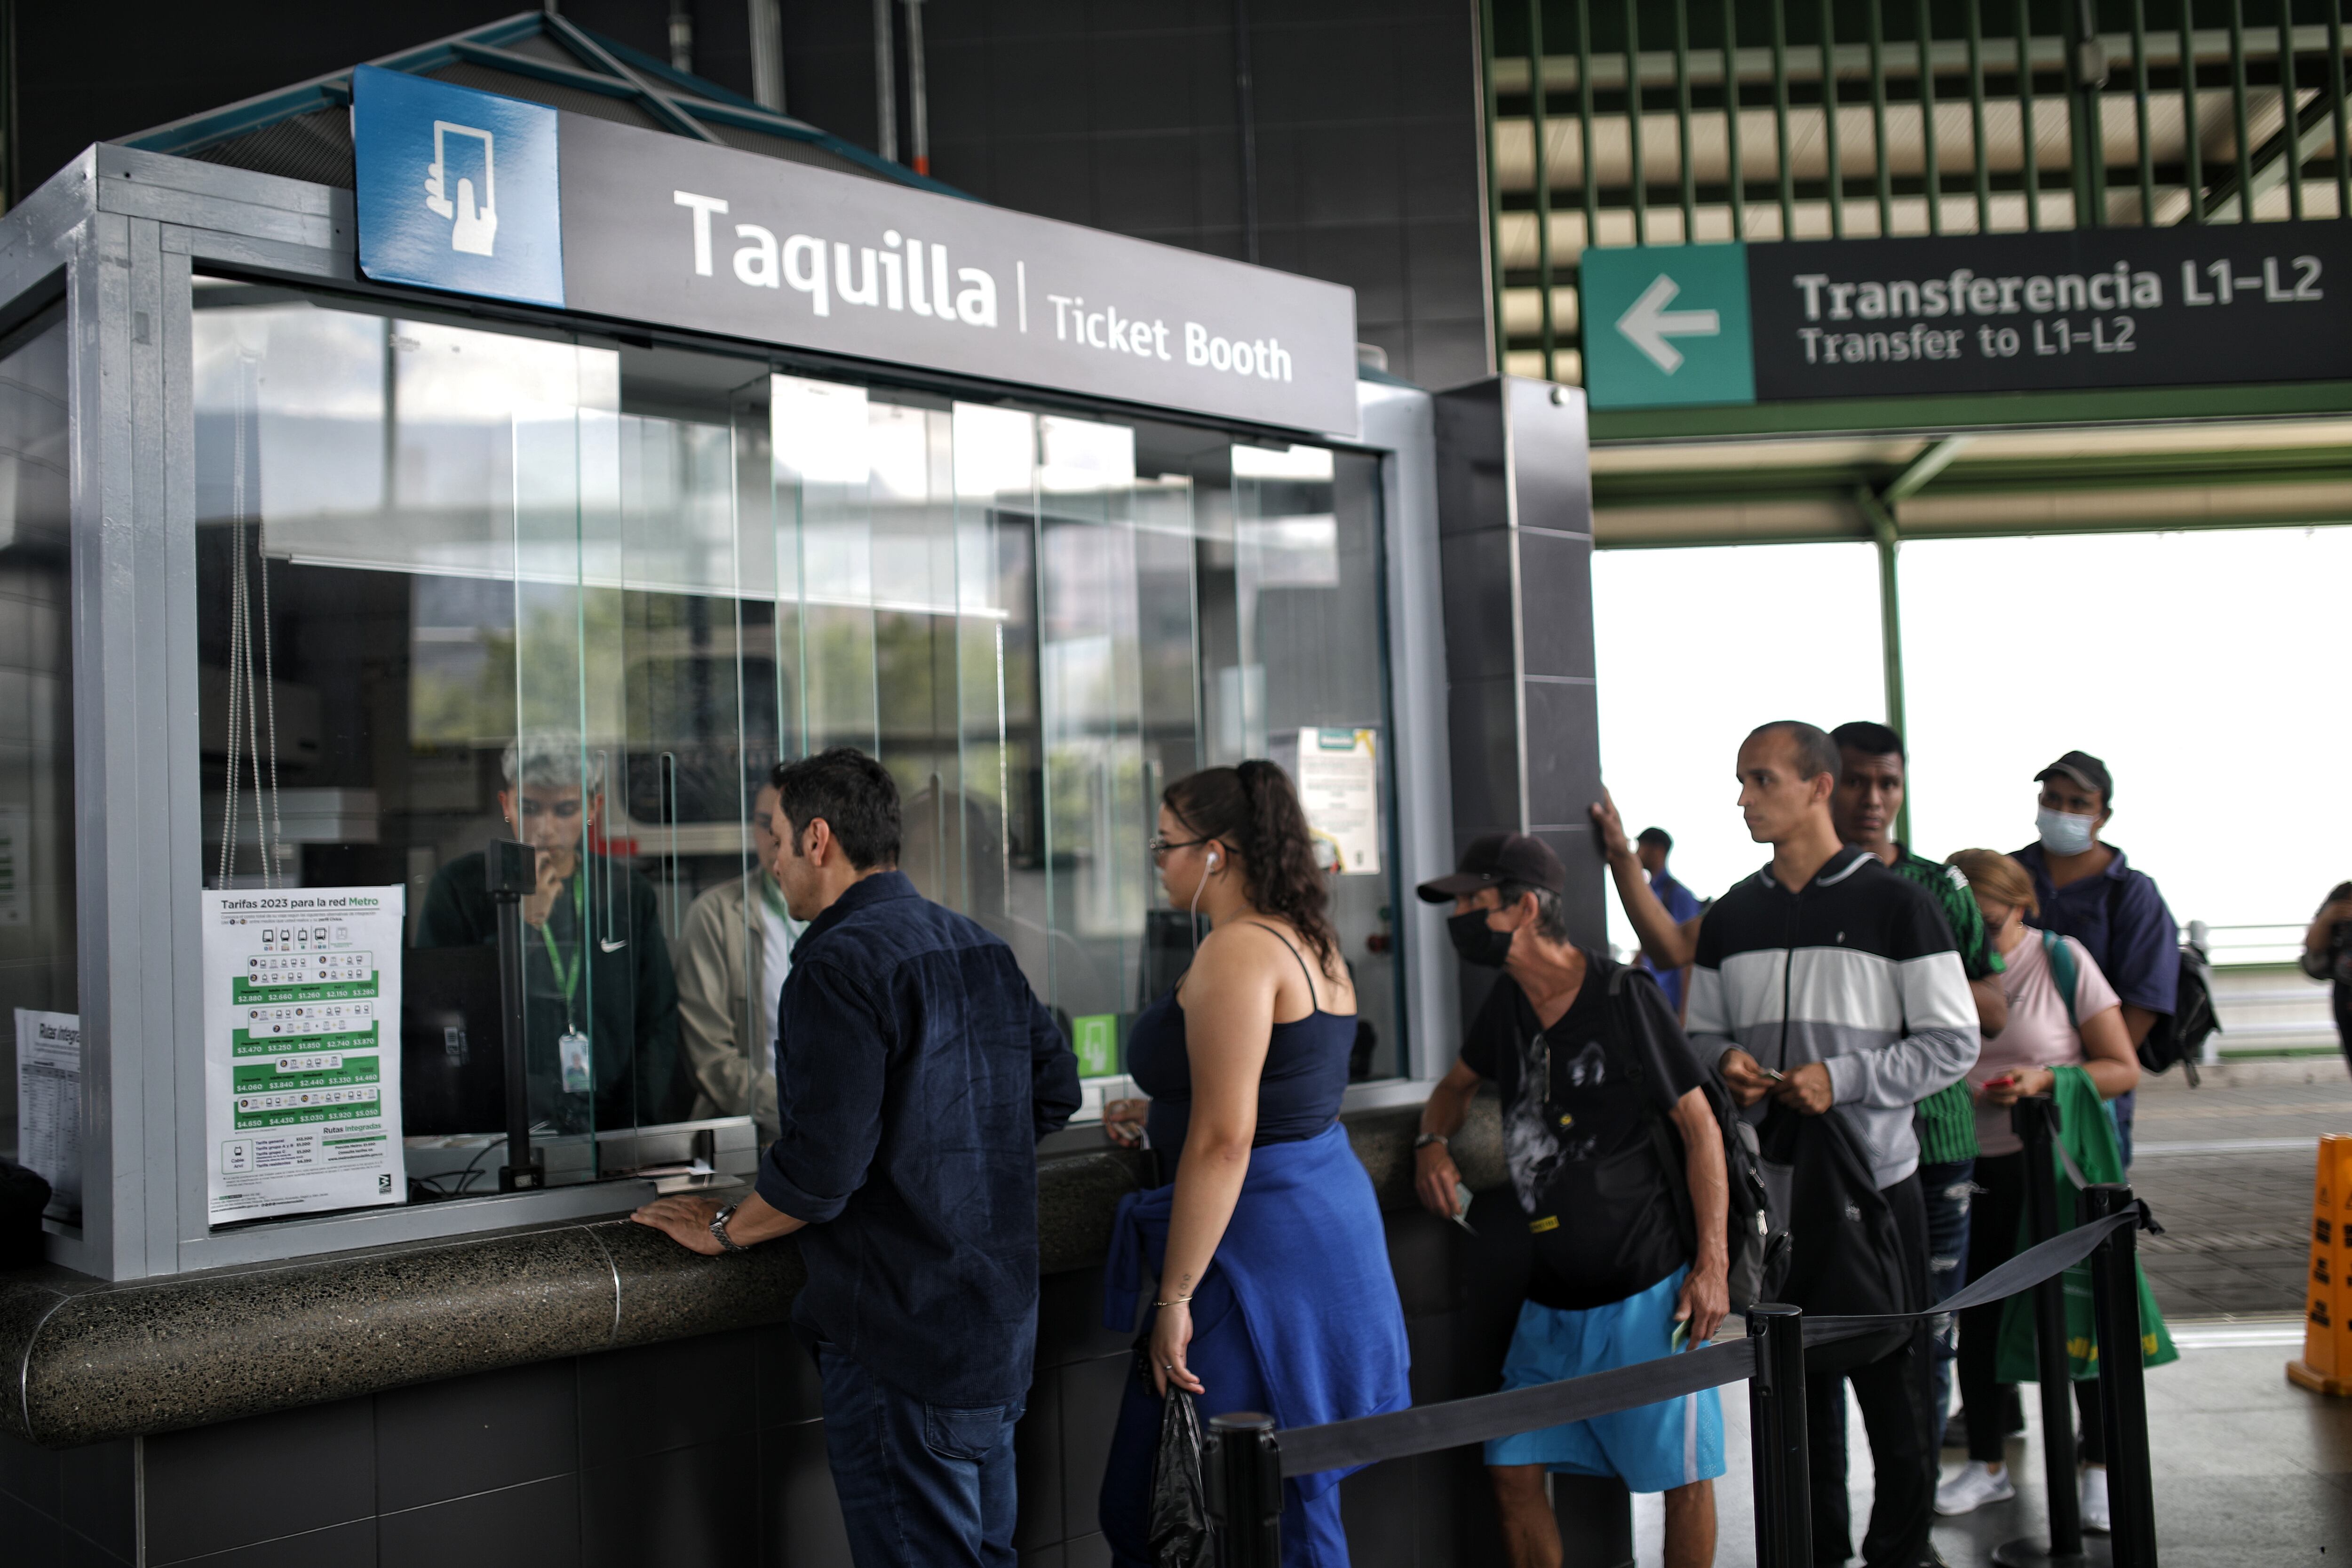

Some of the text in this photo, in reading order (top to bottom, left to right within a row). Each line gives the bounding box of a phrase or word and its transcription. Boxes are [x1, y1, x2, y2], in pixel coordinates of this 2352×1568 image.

[674, 190, 1293, 383] Taquilla Ticket Booth
[1793, 260, 2164, 322] Transferencia
[1796, 323, 1965, 365] Transfer
[1979, 324, 2021, 358] to
[221, 897, 378, 909] Tarifas 2023 para la red Metro
[39, 1023, 56, 1040] Rutas
[345, 1123, 381, 1132] Integradas
